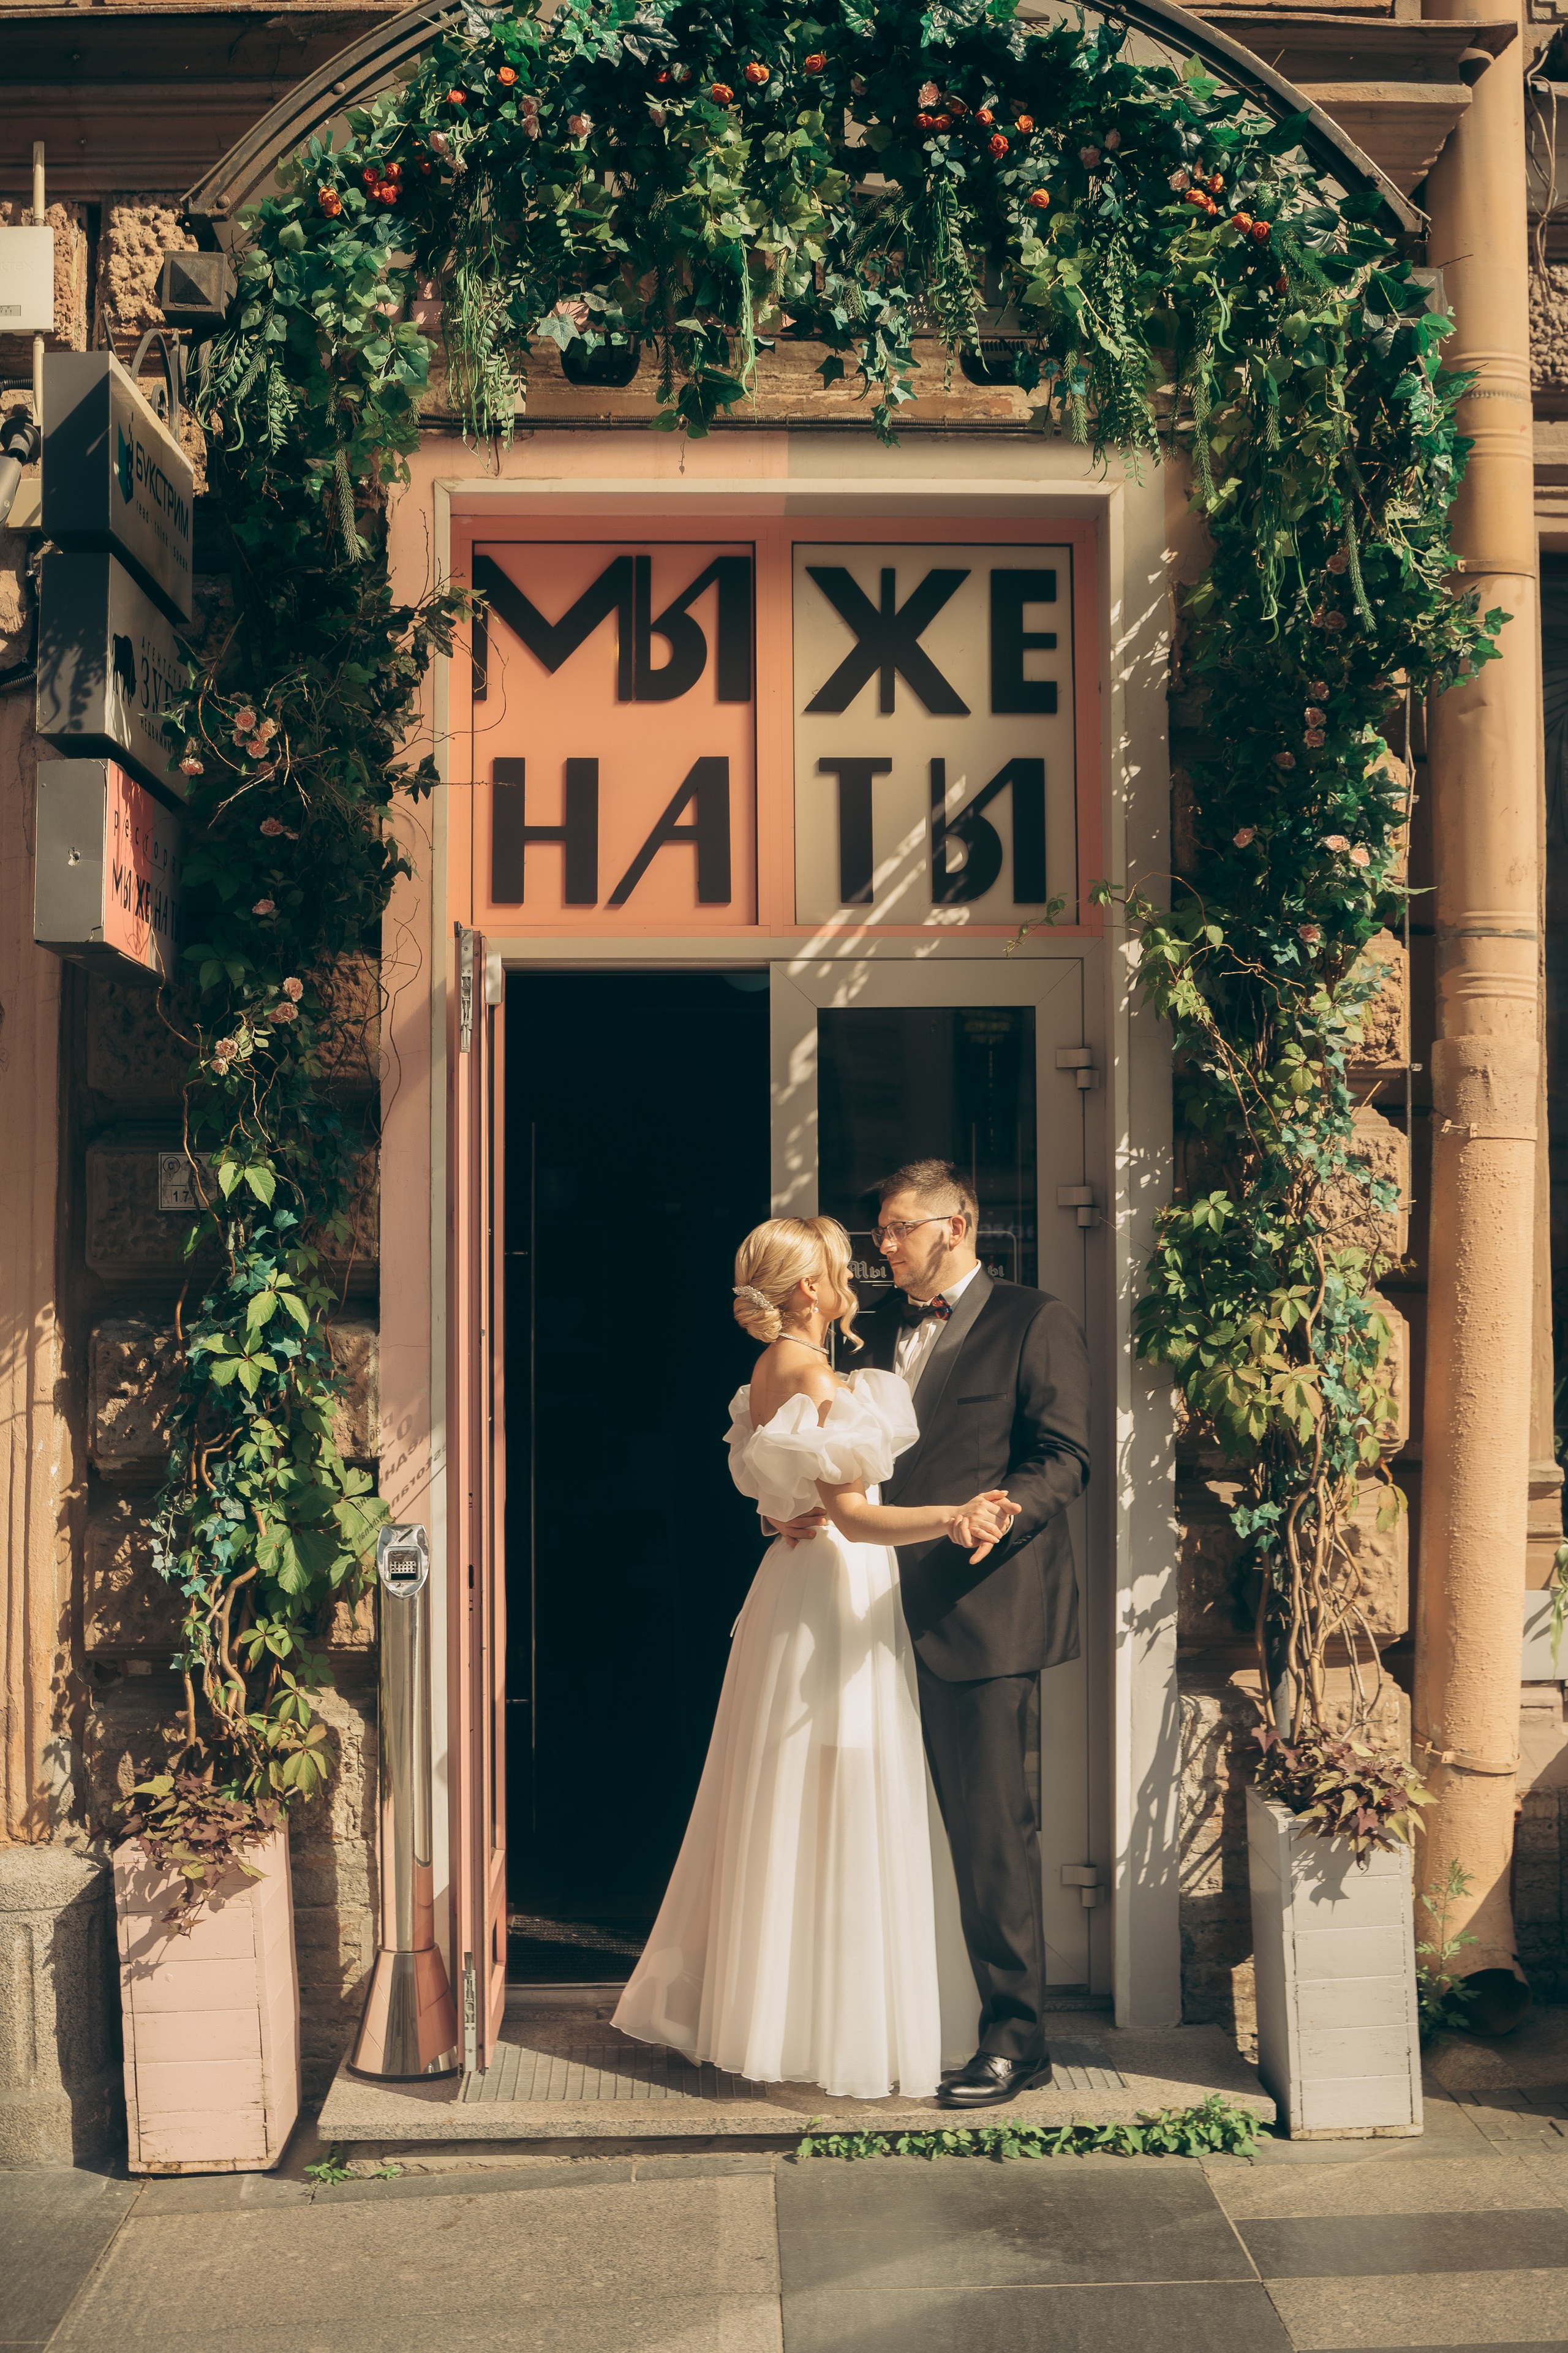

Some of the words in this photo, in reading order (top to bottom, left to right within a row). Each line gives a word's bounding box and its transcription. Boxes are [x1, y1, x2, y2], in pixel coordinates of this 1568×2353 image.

[136, 440, 189, 542] БУКСТРИМ
[136, 500, 149, 524] read
[154, 519, 168, 548] think
[173, 546, 188, 572] speak
[473, 555, 751, 701] МЫ
[804, 567, 1058, 714] ЖЕ
[491, 757, 732, 905] НА
[818, 757, 1047, 905] ТЫ
[111, 858, 132, 913] МЫ
[135, 874, 151, 924] ЖЕ
[154, 891, 168, 935] НА
